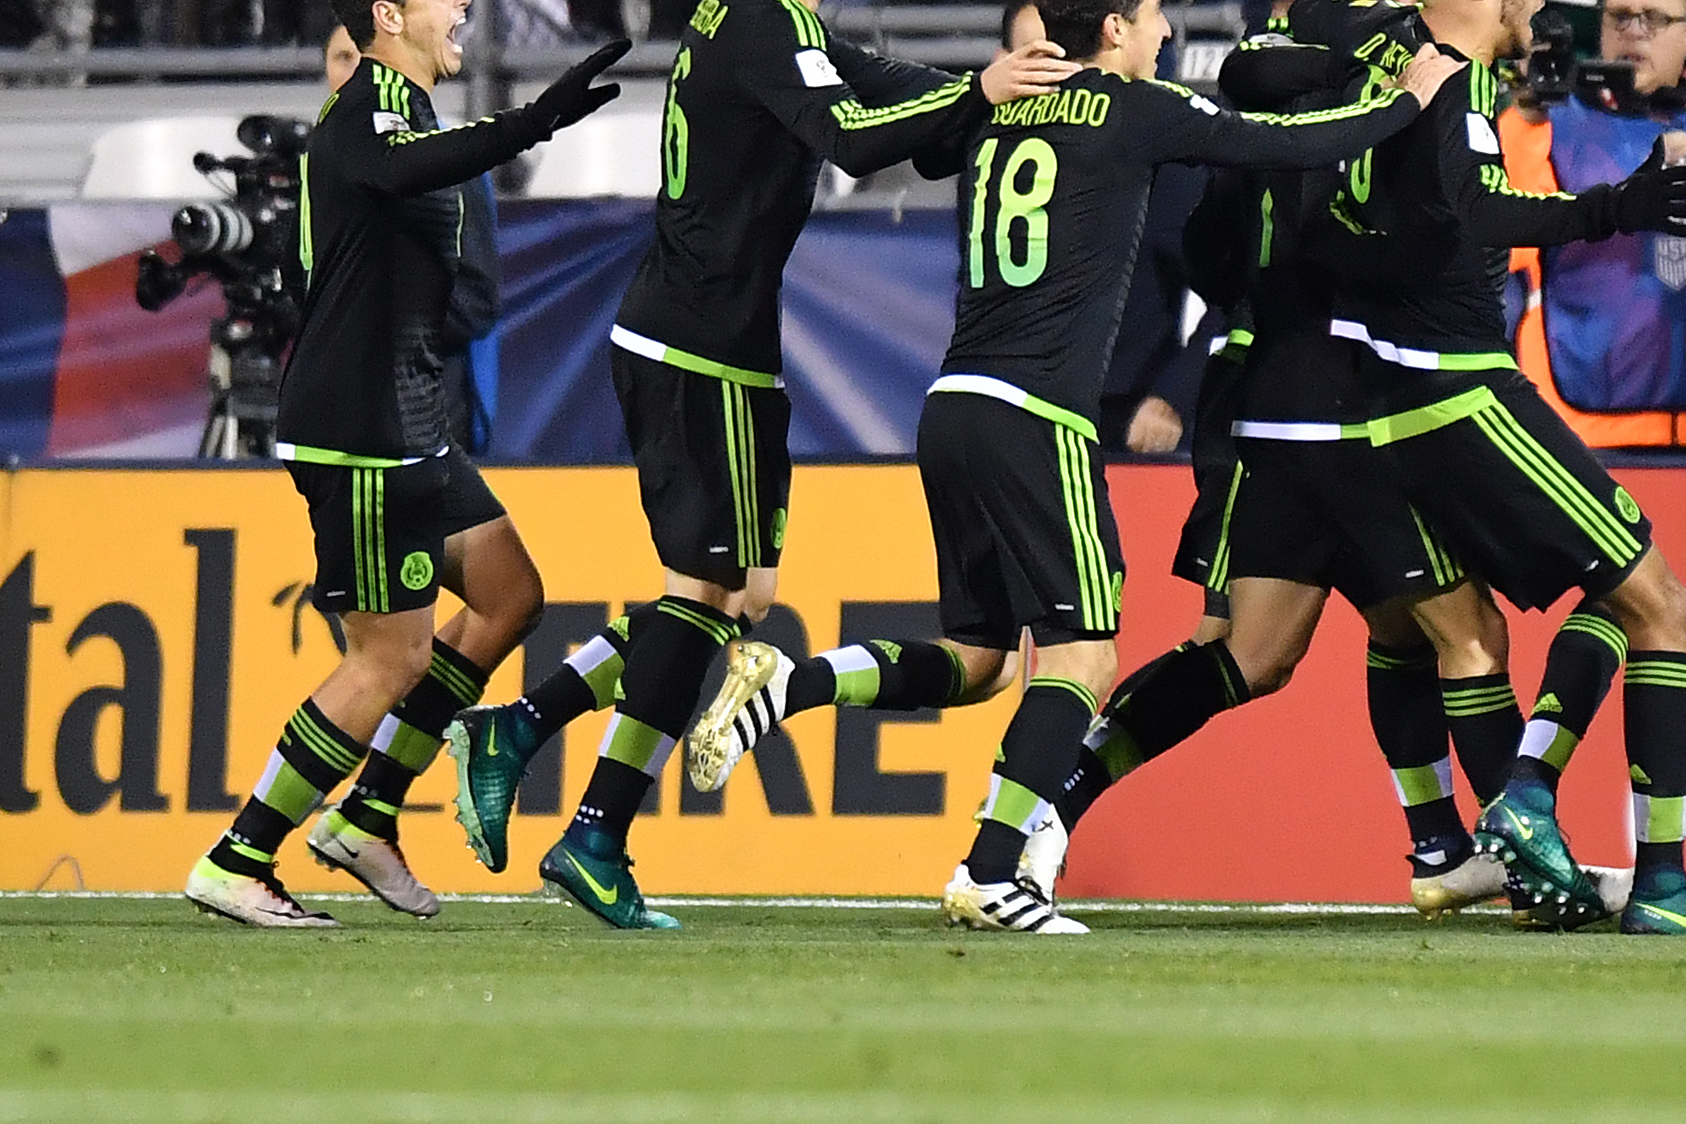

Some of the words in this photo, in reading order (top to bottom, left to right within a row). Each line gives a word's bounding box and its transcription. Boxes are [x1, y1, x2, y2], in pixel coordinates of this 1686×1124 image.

[968, 136, 1059, 289] 18
[0, 527, 243, 816] tal
[516, 601, 948, 817] TRE
